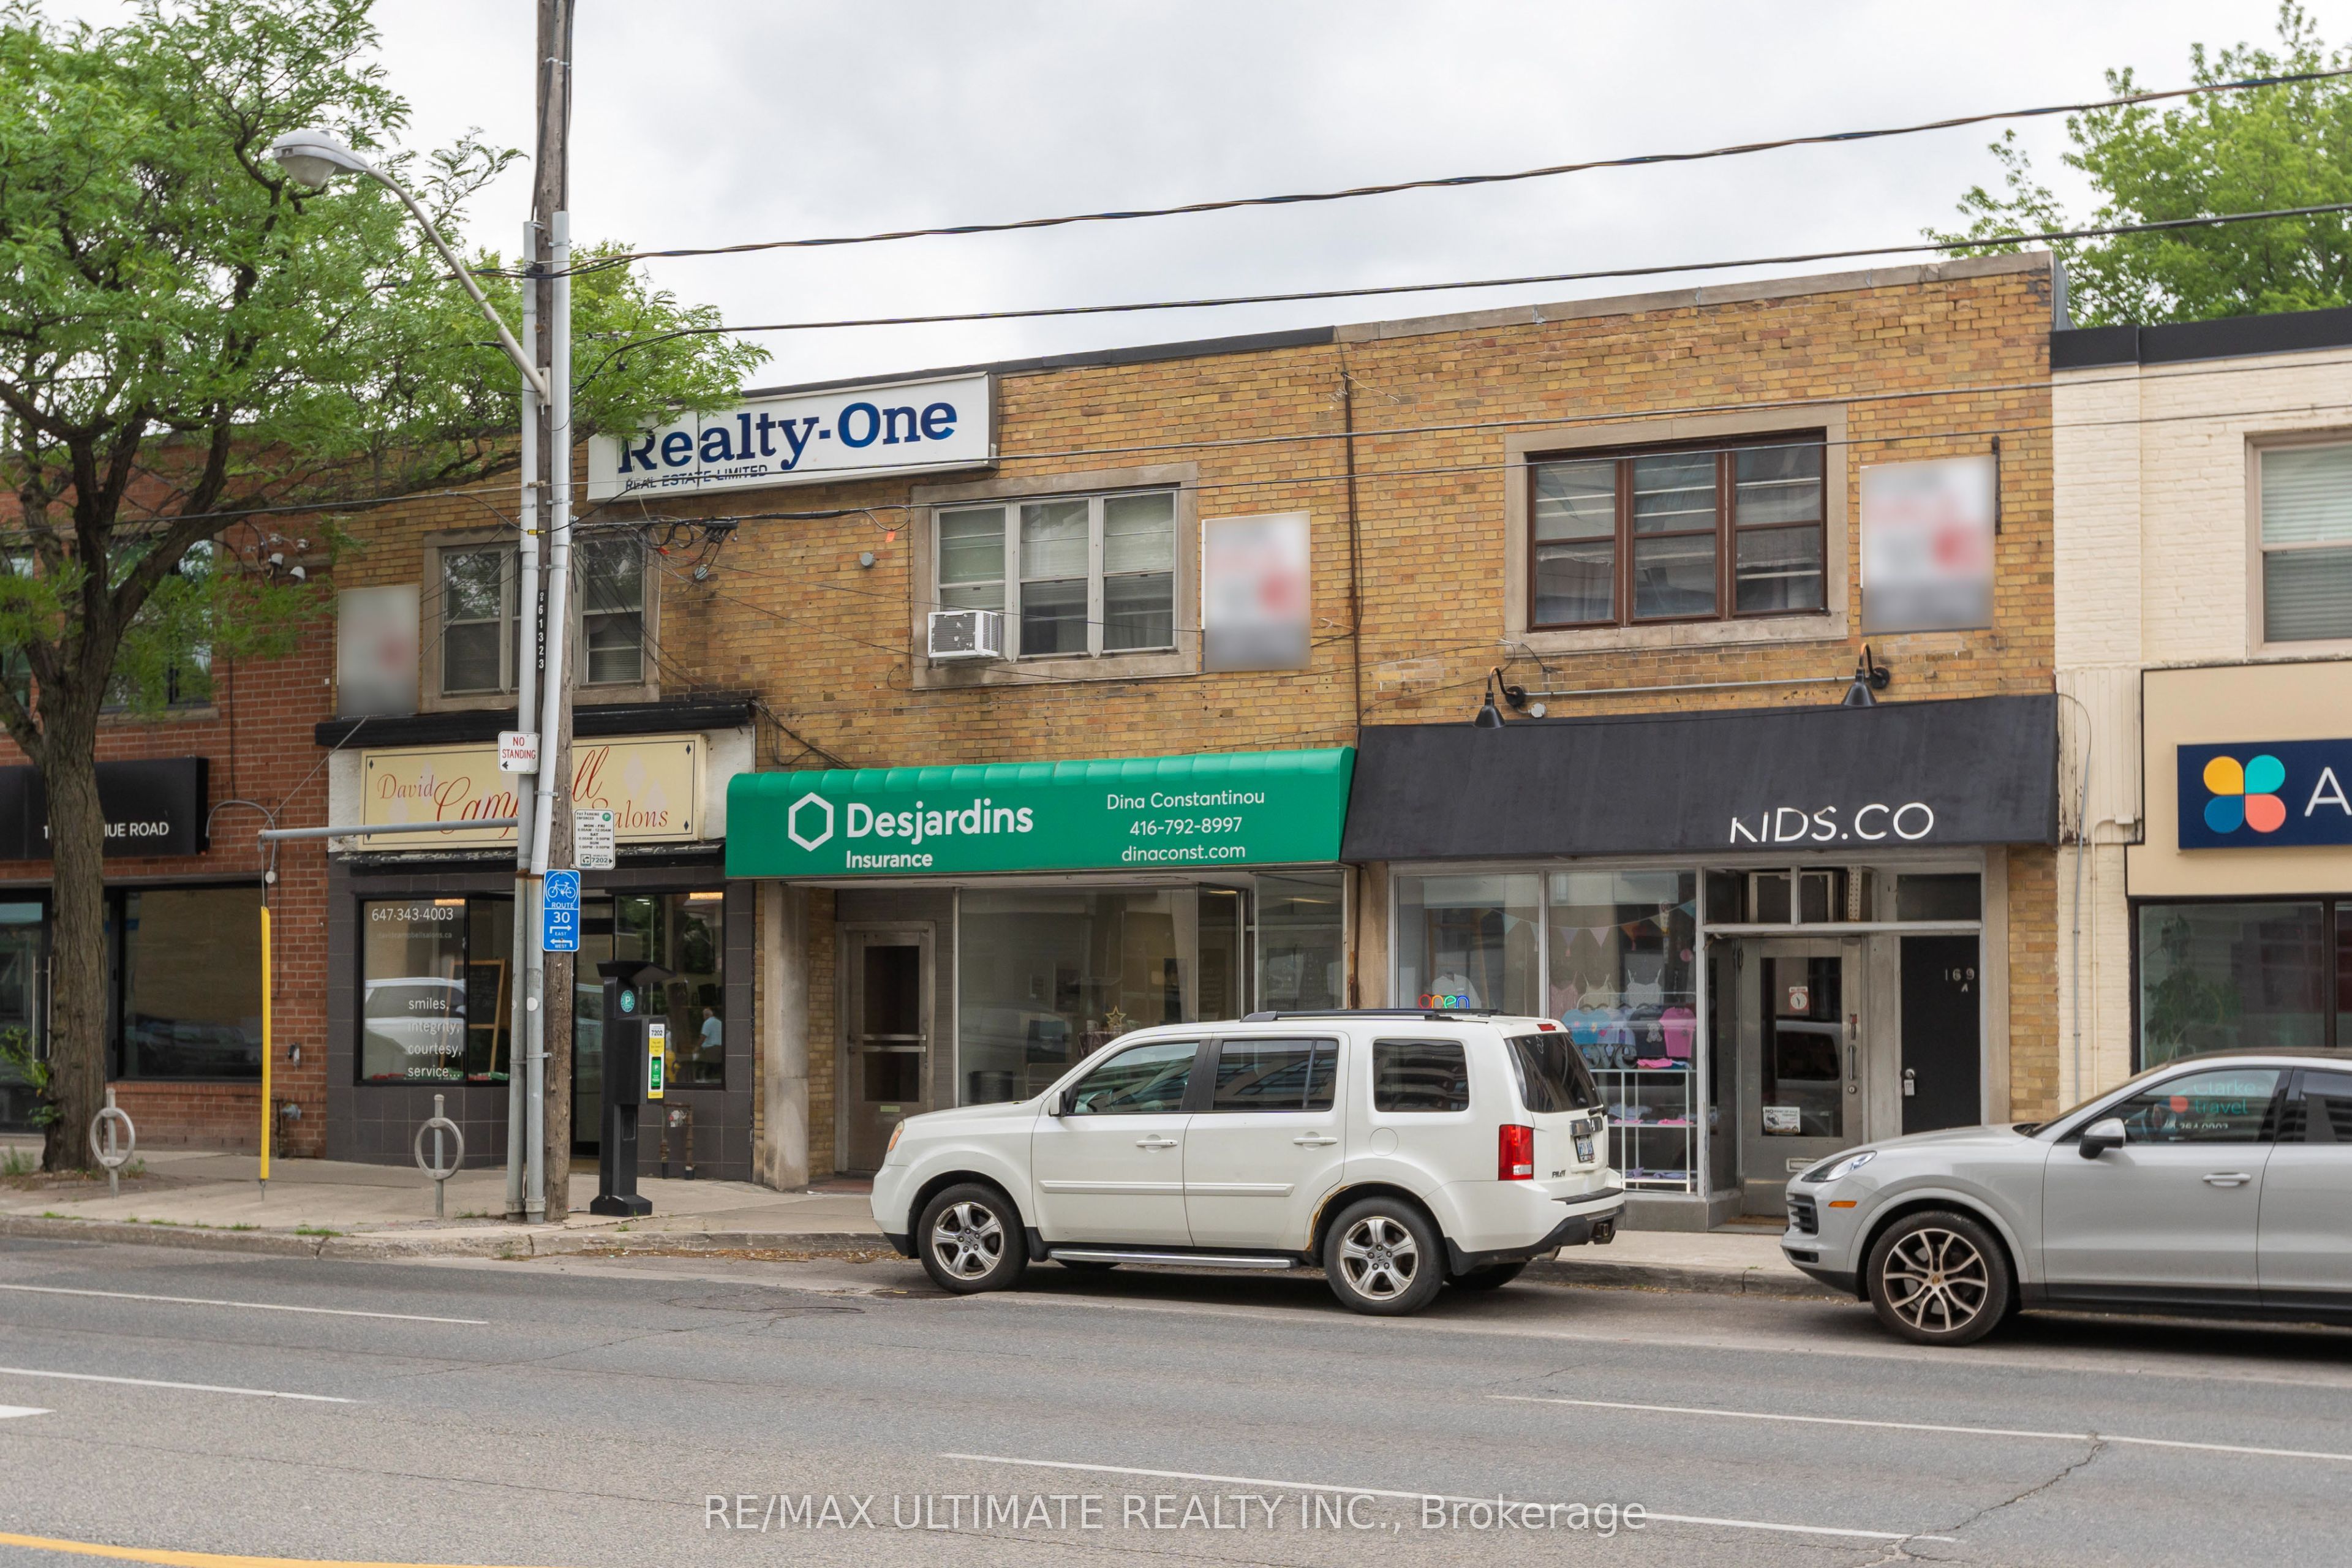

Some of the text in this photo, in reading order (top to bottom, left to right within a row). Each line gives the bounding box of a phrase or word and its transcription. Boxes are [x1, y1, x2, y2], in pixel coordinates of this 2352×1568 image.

[618, 402, 957, 473] Realty-One
[662, 470, 712, 486] ESTATE
[717, 464, 767, 481] LIMITED
[513, 737, 525, 747] NO
[502, 748, 537, 760] STANDING
[377, 774, 435, 799] David
[592, 798, 668, 828] alons
[1107, 790, 1265, 810] Dina Constantinou
[129, 821, 170, 837] ROAD
[847, 798, 1033, 845] Desjardins
[1129, 816, 1243, 835] 416-792-8997
[1729, 802, 1934, 844] KIDS.CO
[846, 851, 933, 869] Insurance
[1121, 844, 1246, 861] dinaconst.com
[553, 911, 570, 923] 30
[1945, 968, 1975, 981] 169
[408, 997, 450, 1011] smiles,
[407, 1042, 461, 1058] courtesy,
[2195, 1098, 2248, 1115] travel
[1551, 1169, 1566, 1178] PILOT
